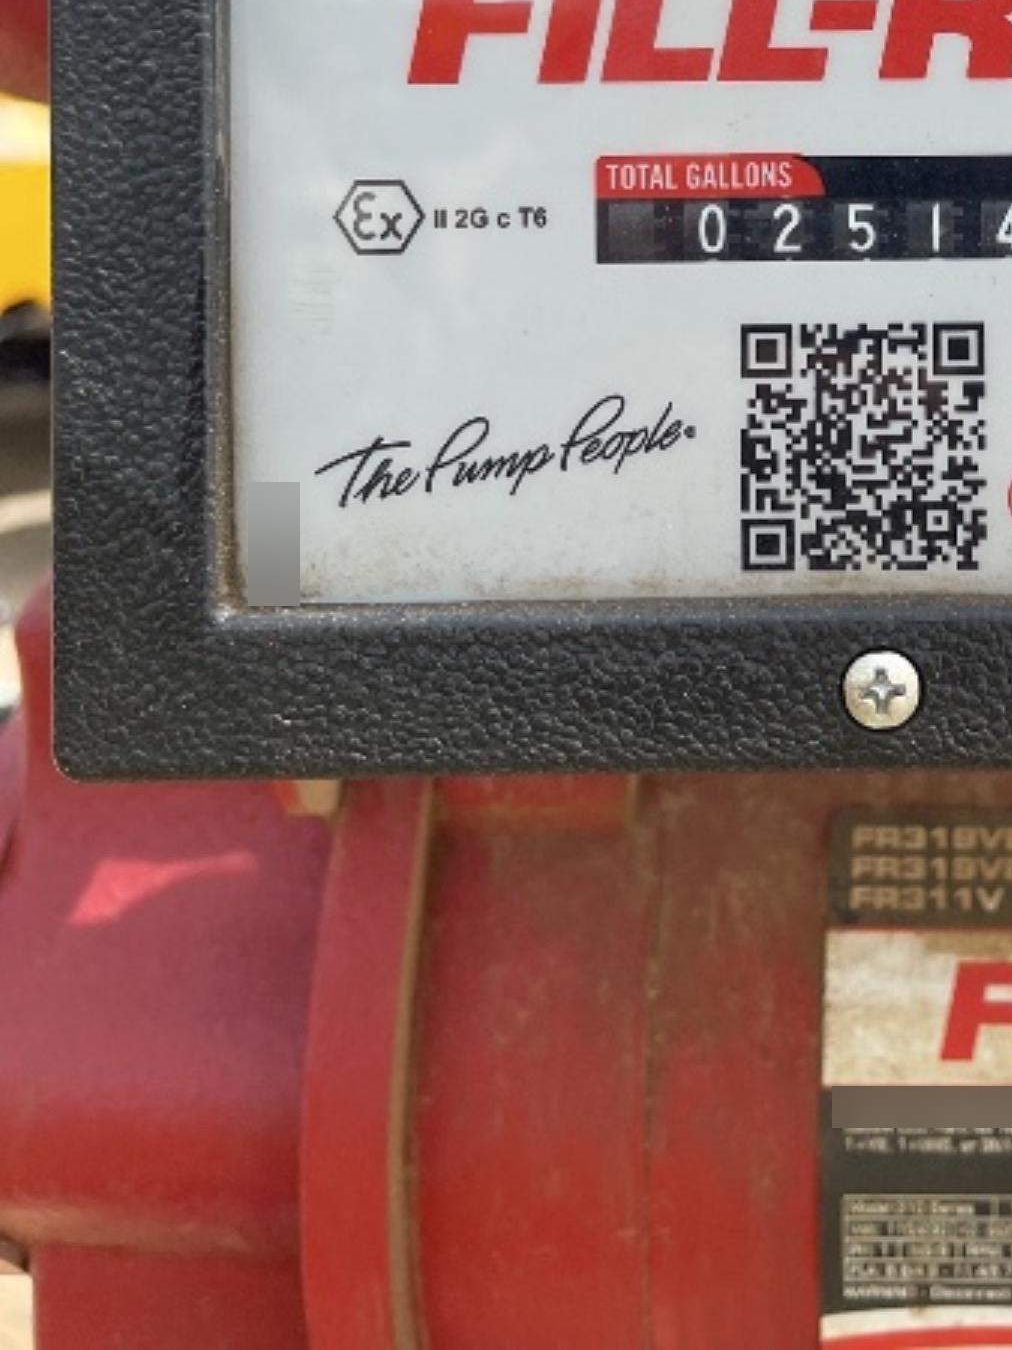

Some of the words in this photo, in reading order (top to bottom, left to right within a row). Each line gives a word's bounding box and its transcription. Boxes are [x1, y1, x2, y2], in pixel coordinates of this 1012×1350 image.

[605, 164, 678, 190] TOTAL
[686, 161, 793, 188] GALLONS
[455, 209, 489, 229] 2G
[518, 206, 547, 229] T6
[314, 437, 421, 508] The
[425, 416, 555, 496] Pump
